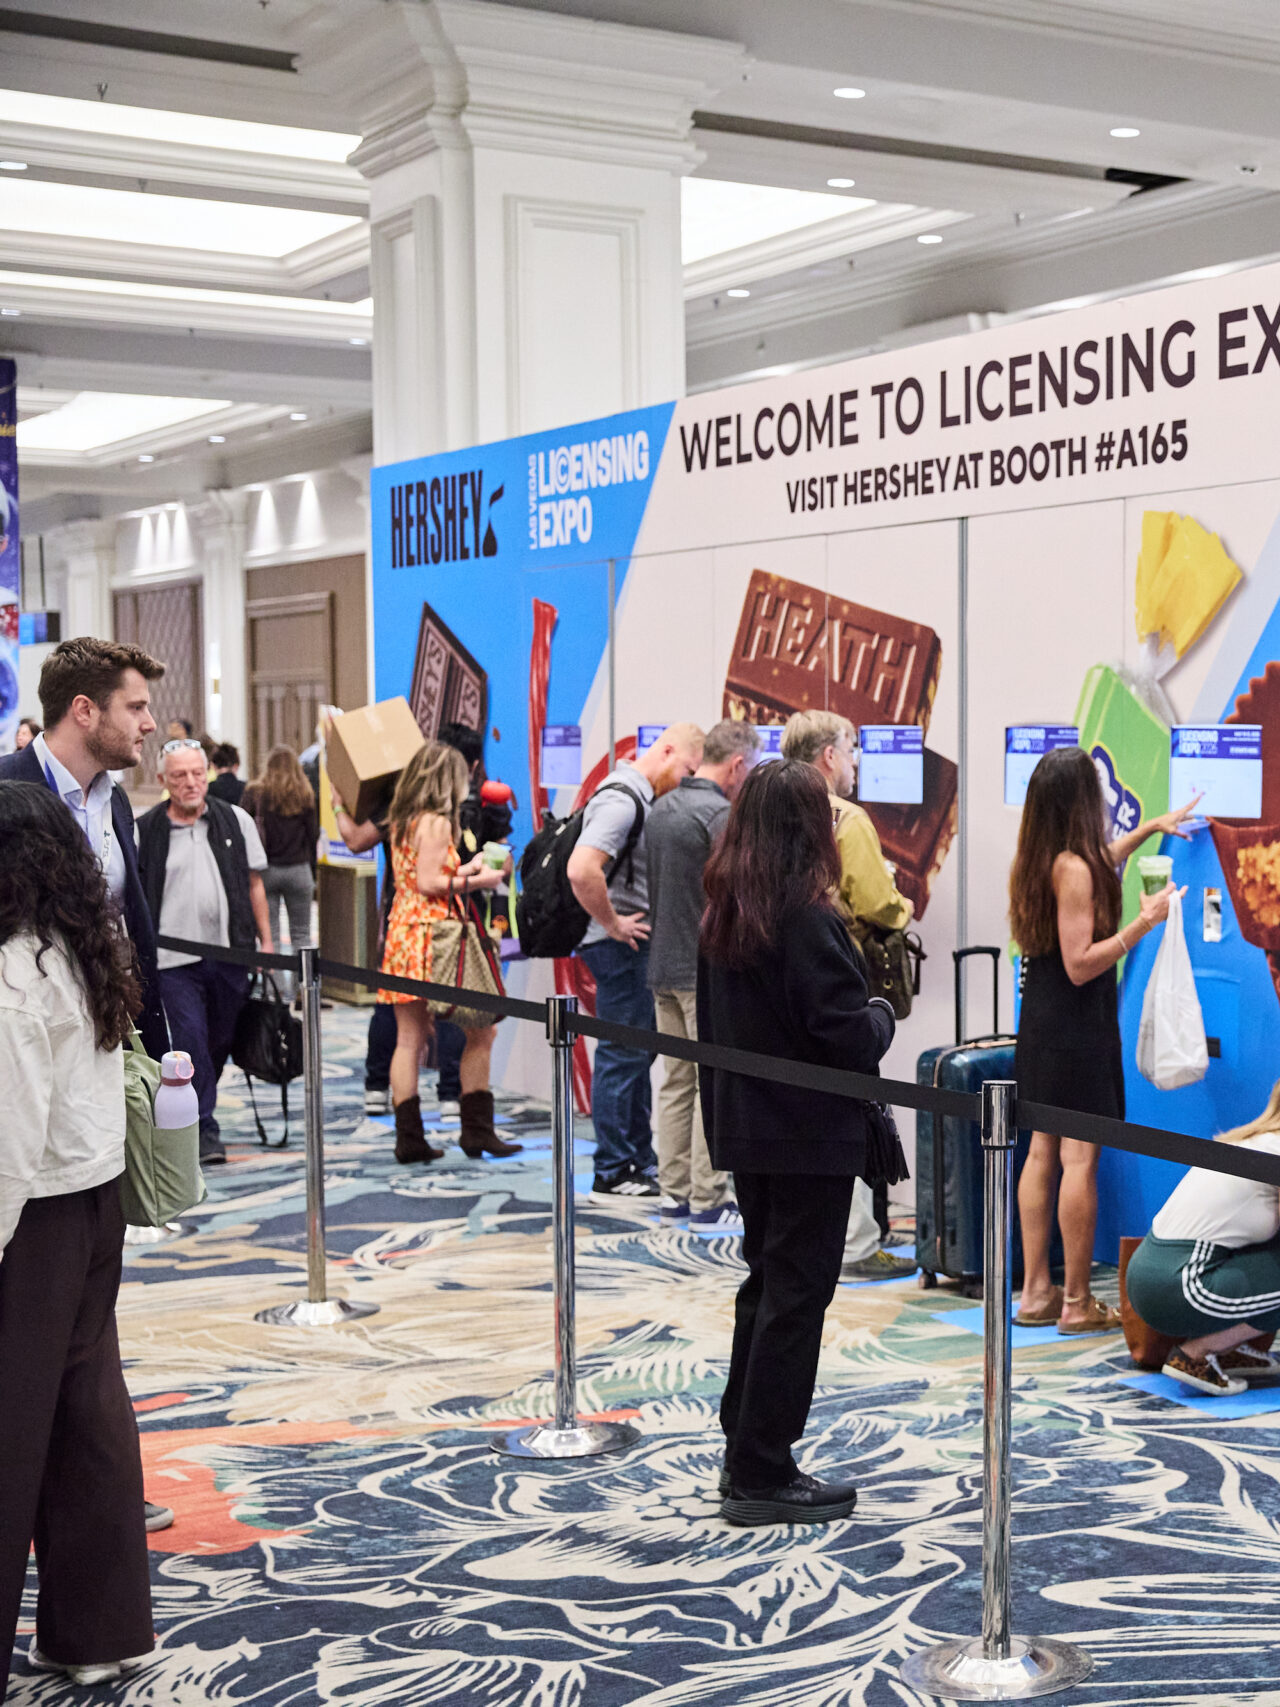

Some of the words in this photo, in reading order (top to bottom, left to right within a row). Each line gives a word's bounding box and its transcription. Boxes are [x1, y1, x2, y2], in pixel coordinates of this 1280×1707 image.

[680, 390, 859, 474] WELCOME
[870, 376, 925, 440] TO
[939, 319, 1196, 429] LICENSING
[786, 475, 839, 514] VISIT
[843, 459, 950, 506] HERSHEY
[953, 451, 982, 492] AT
[990, 435, 1087, 487] BOOTH
[1095, 418, 1189, 472] #A165
[390, 469, 483, 569] HERSHEY
[539, 495, 593, 548] EXPO
[742, 591, 917, 724] HEATH
